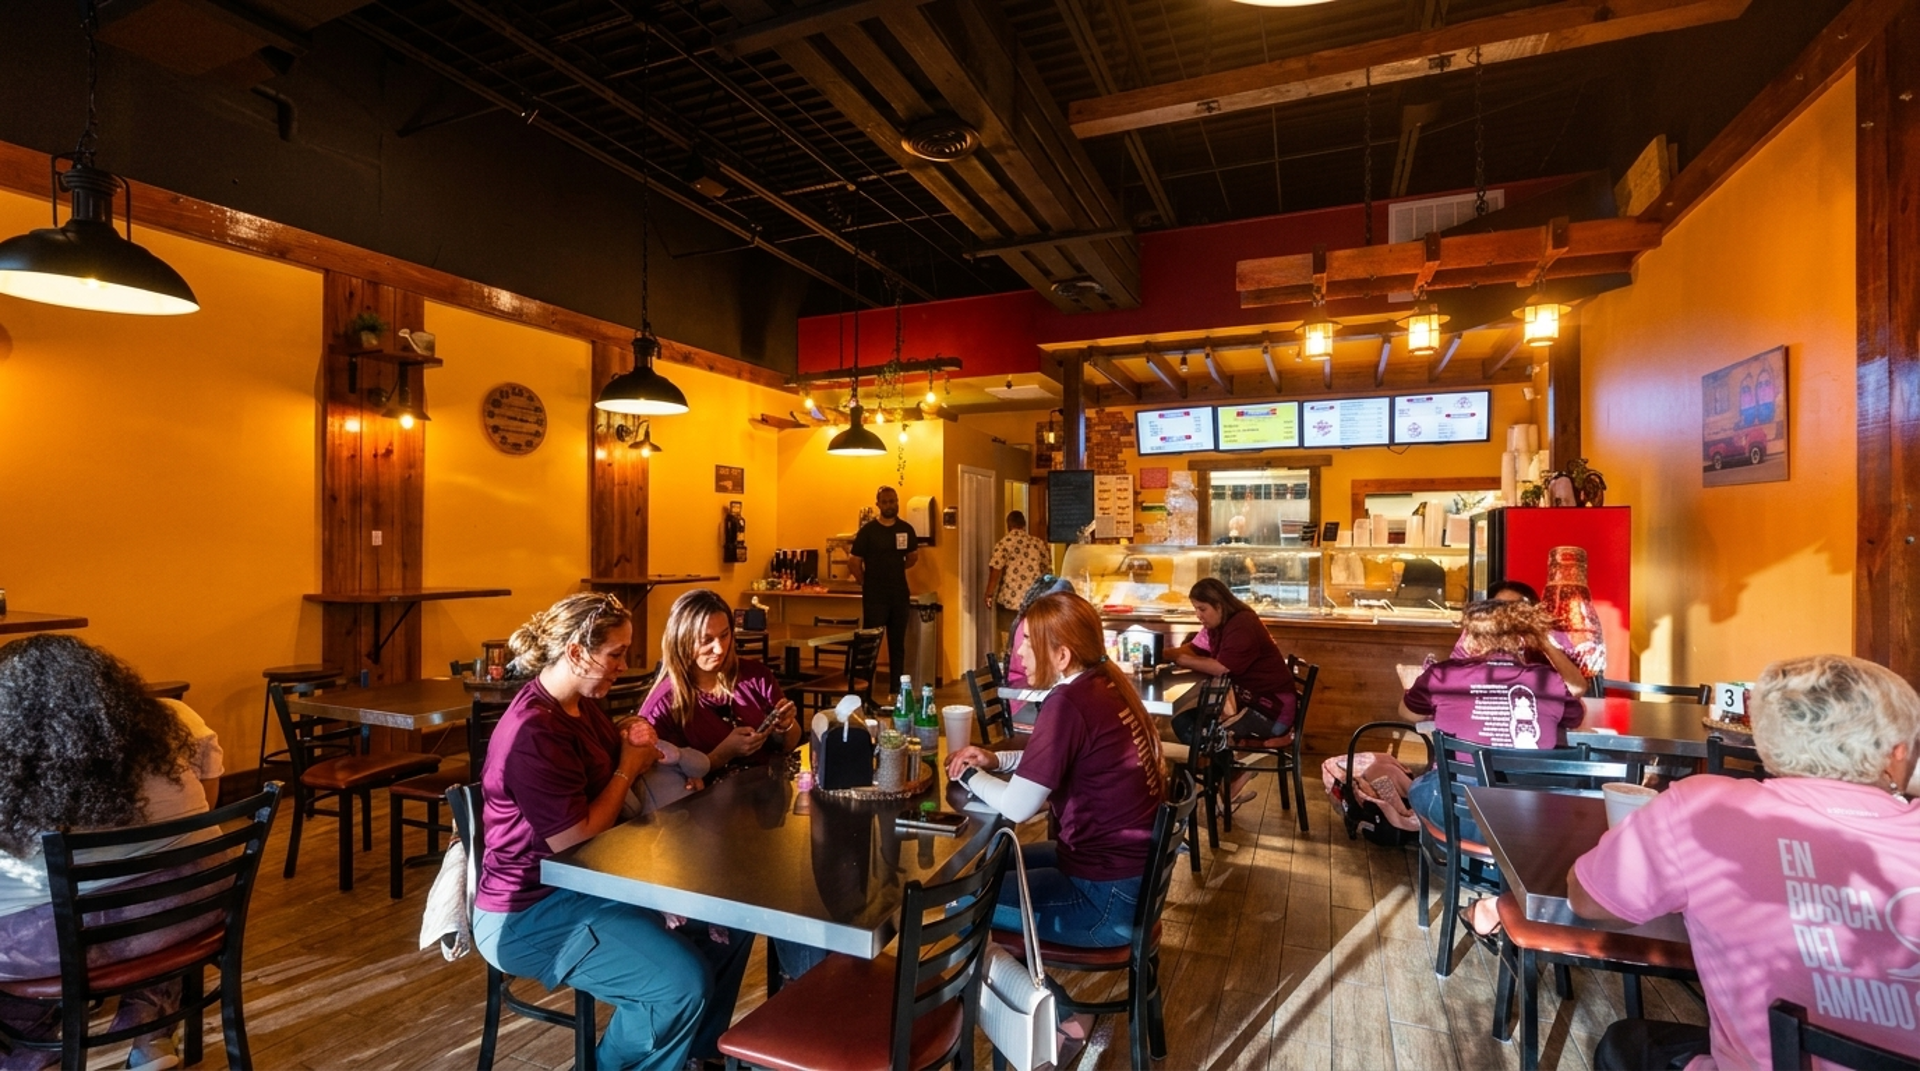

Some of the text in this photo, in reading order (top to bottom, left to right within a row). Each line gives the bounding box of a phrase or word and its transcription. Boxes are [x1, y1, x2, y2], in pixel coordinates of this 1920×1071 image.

[1725, 689, 1734, 707] 3
[1777, 838, 1816, 879] EN
[1785, 880, 1883, 931] BUSCA
[1793, 924, 1852, 974] DEL
[1812, 972, 1916, 1031] AMADO
